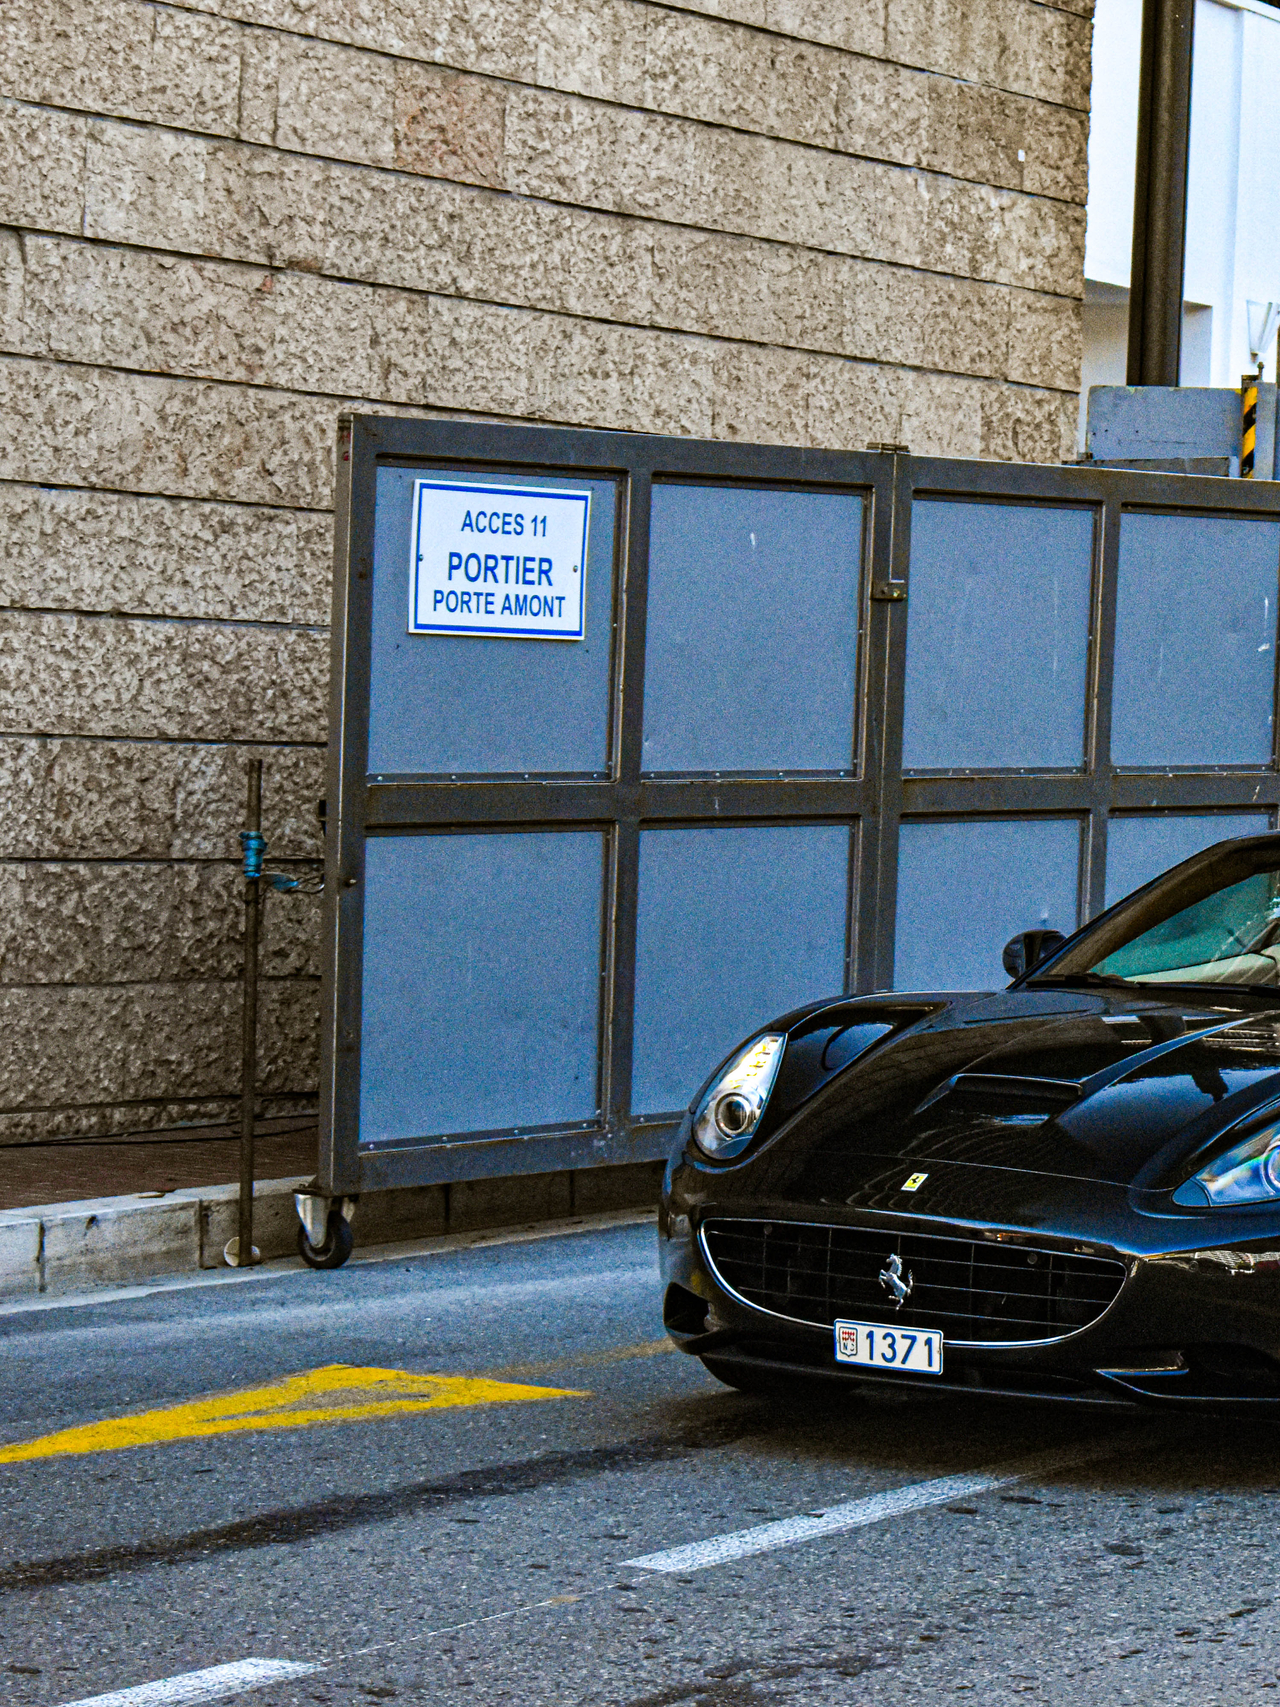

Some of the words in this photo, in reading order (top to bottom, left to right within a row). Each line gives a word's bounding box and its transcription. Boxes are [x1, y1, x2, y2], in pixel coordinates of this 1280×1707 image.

[461, 510, 524, 536] ACCES
[531, 515, 547, 537] 11
[448, 551, 553, 586] PORTIER
[433, 589, 495, 615] PORTE
[500, 593, 566, 617] AMONT
[866, 1330, 933, 1367] 1371
